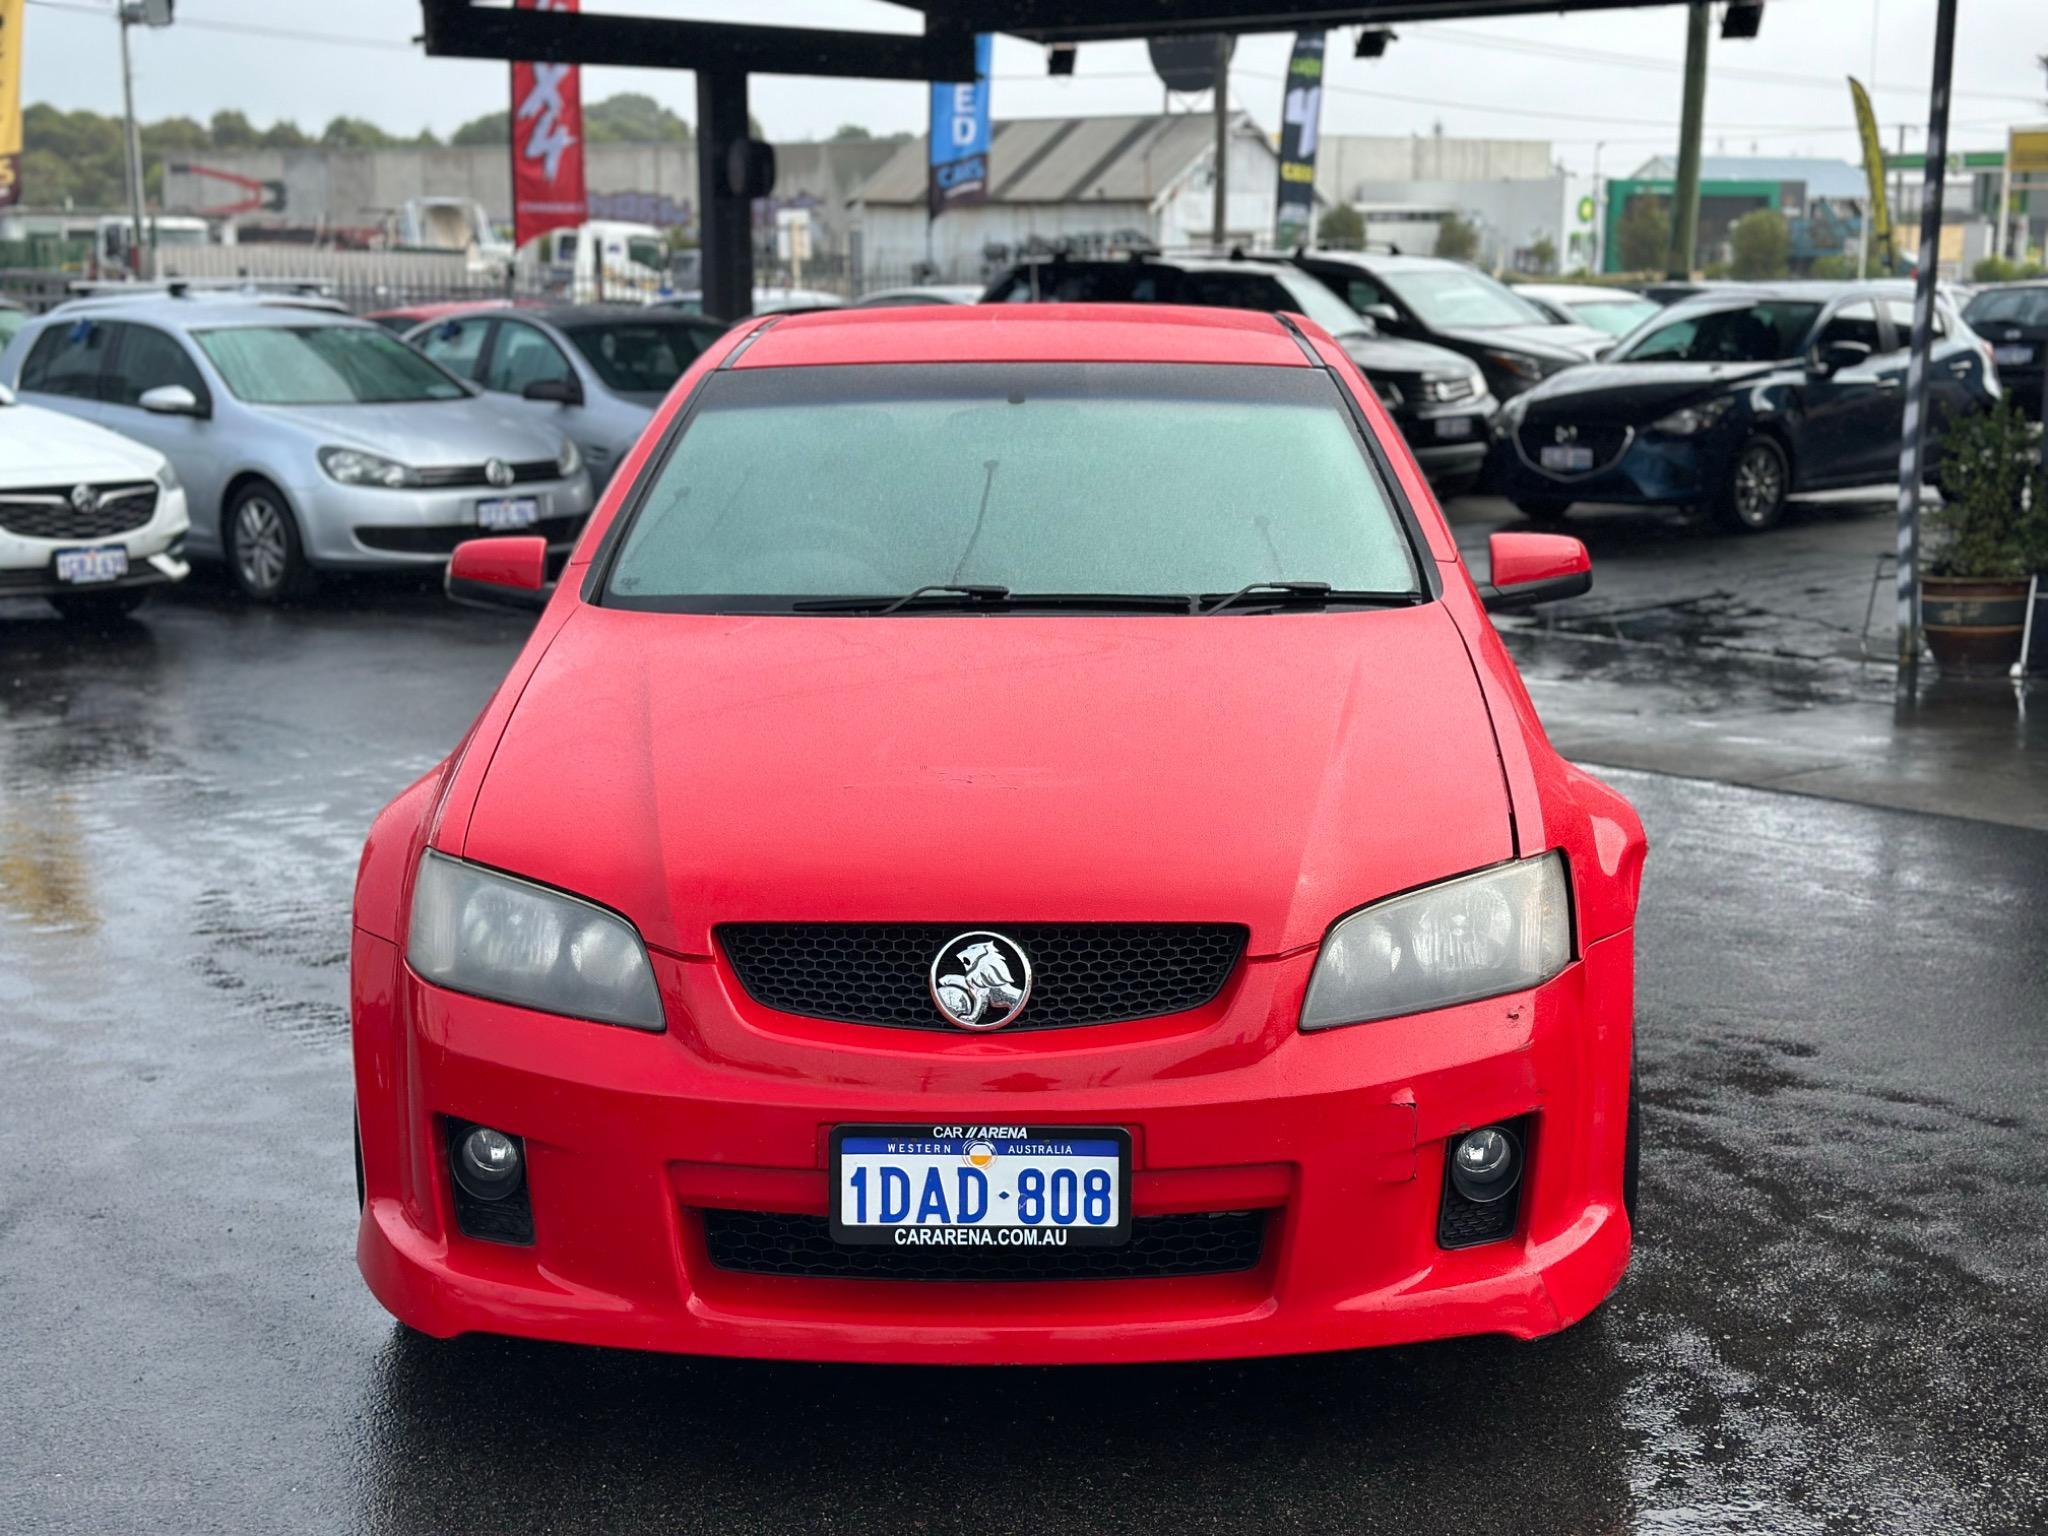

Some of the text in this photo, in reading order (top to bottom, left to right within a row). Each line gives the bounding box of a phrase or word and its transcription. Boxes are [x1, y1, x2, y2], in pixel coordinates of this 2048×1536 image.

[933, 1126, 963, 1139] CAR
[887, 1143, 1073, 1155] WESTERN AUSTRALIA
[894, 1228, 1067, 1246] CARARENA.COM.AU
